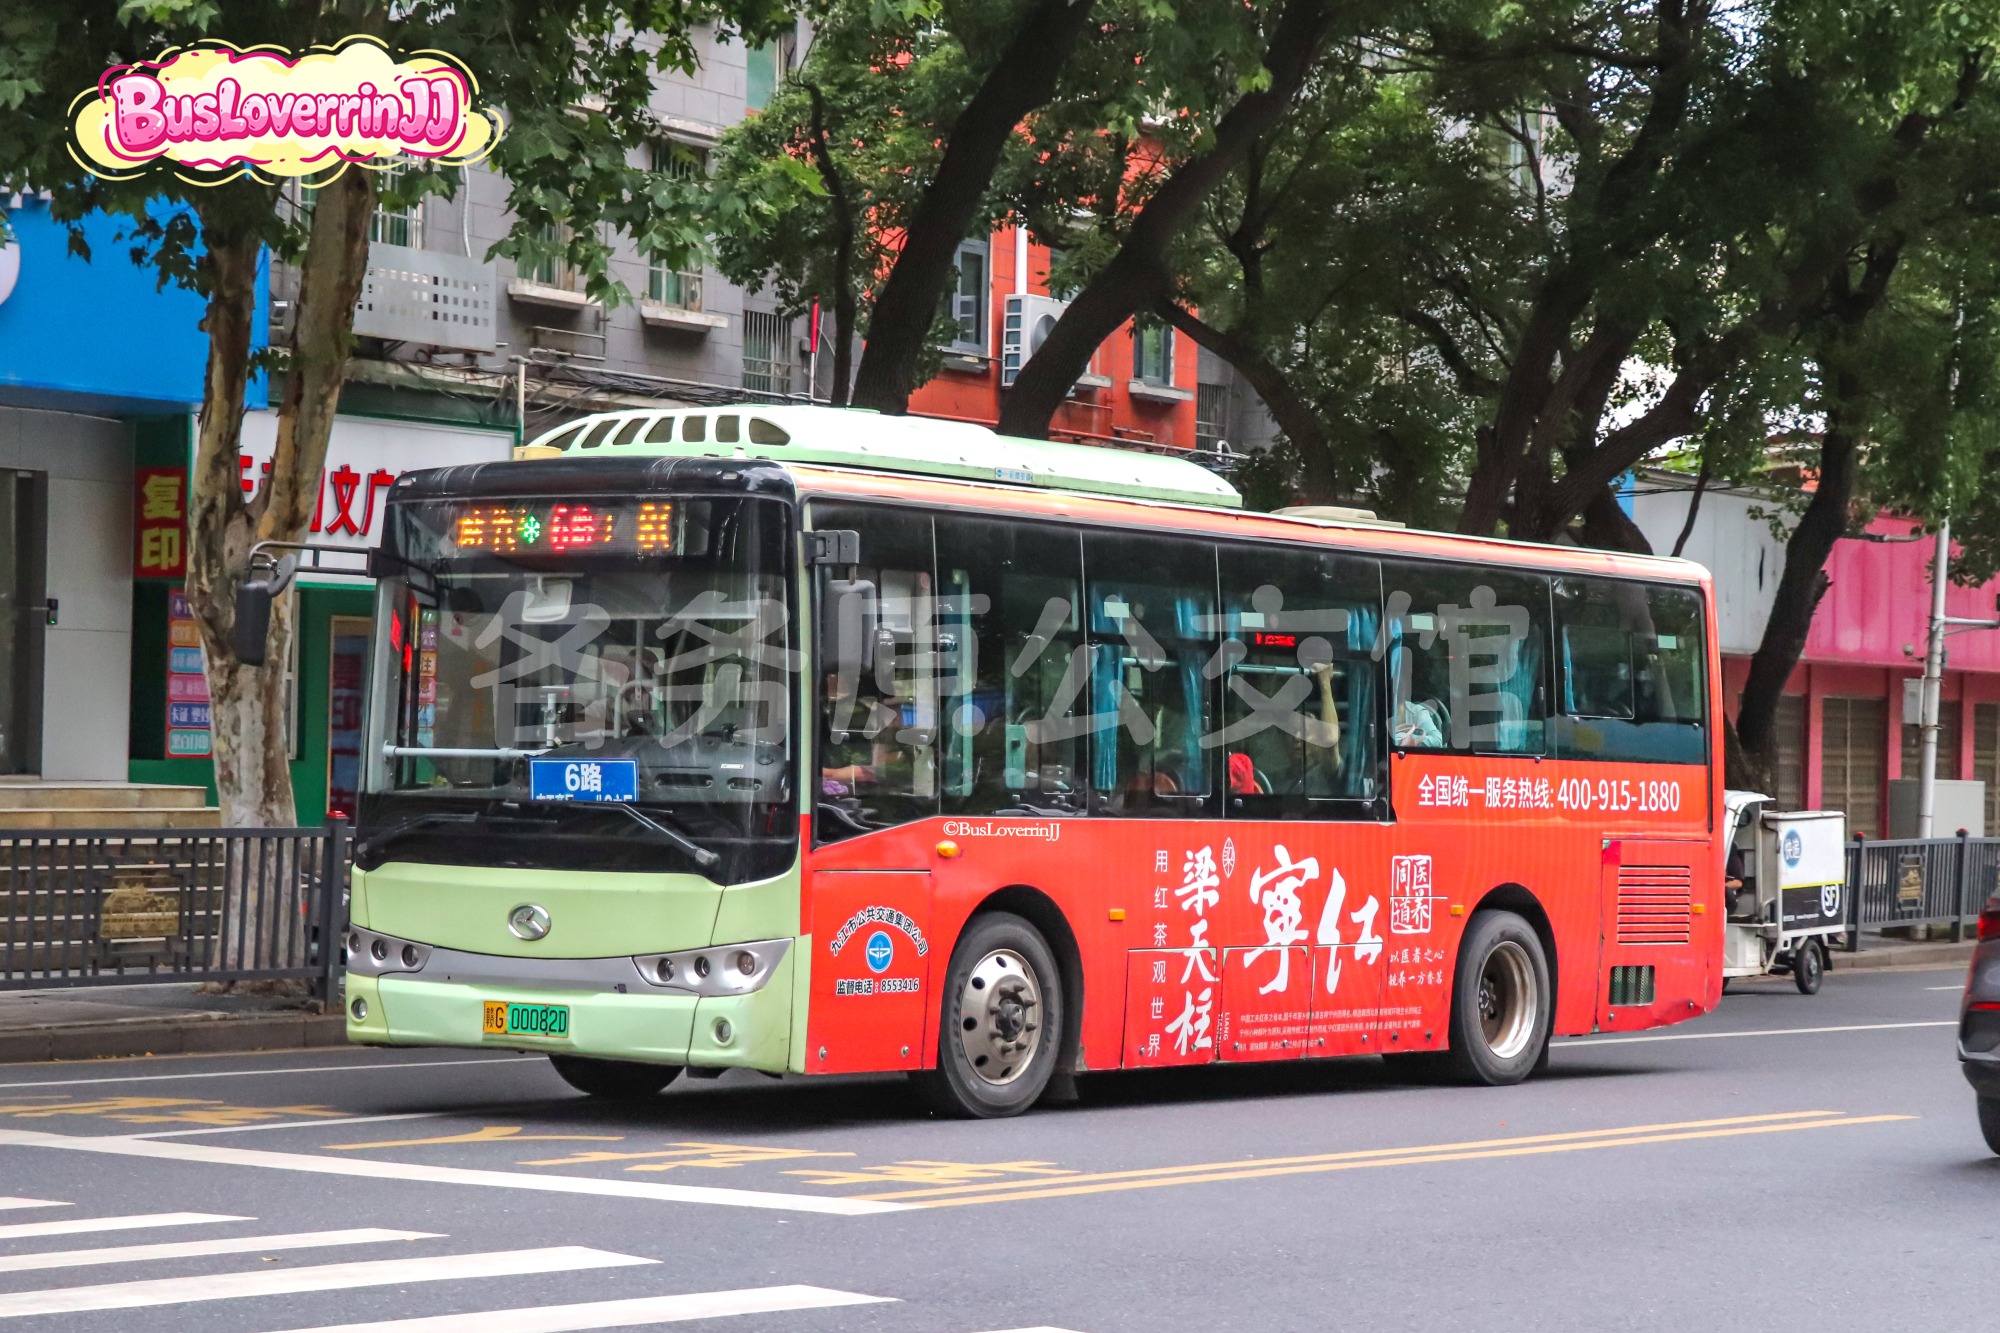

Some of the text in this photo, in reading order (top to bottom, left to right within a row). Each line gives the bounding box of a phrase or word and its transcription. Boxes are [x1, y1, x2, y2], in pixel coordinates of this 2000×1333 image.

[142, 475, 182, 570] 复印
[565, 763, 602, 792] 6路
[1557, 778, 1680, 811] 400-915-1880
[831, 906, 928, 956] 九江市公共交通集团公司
[1147, 850, 1168, 1057] 用红茶观世界
